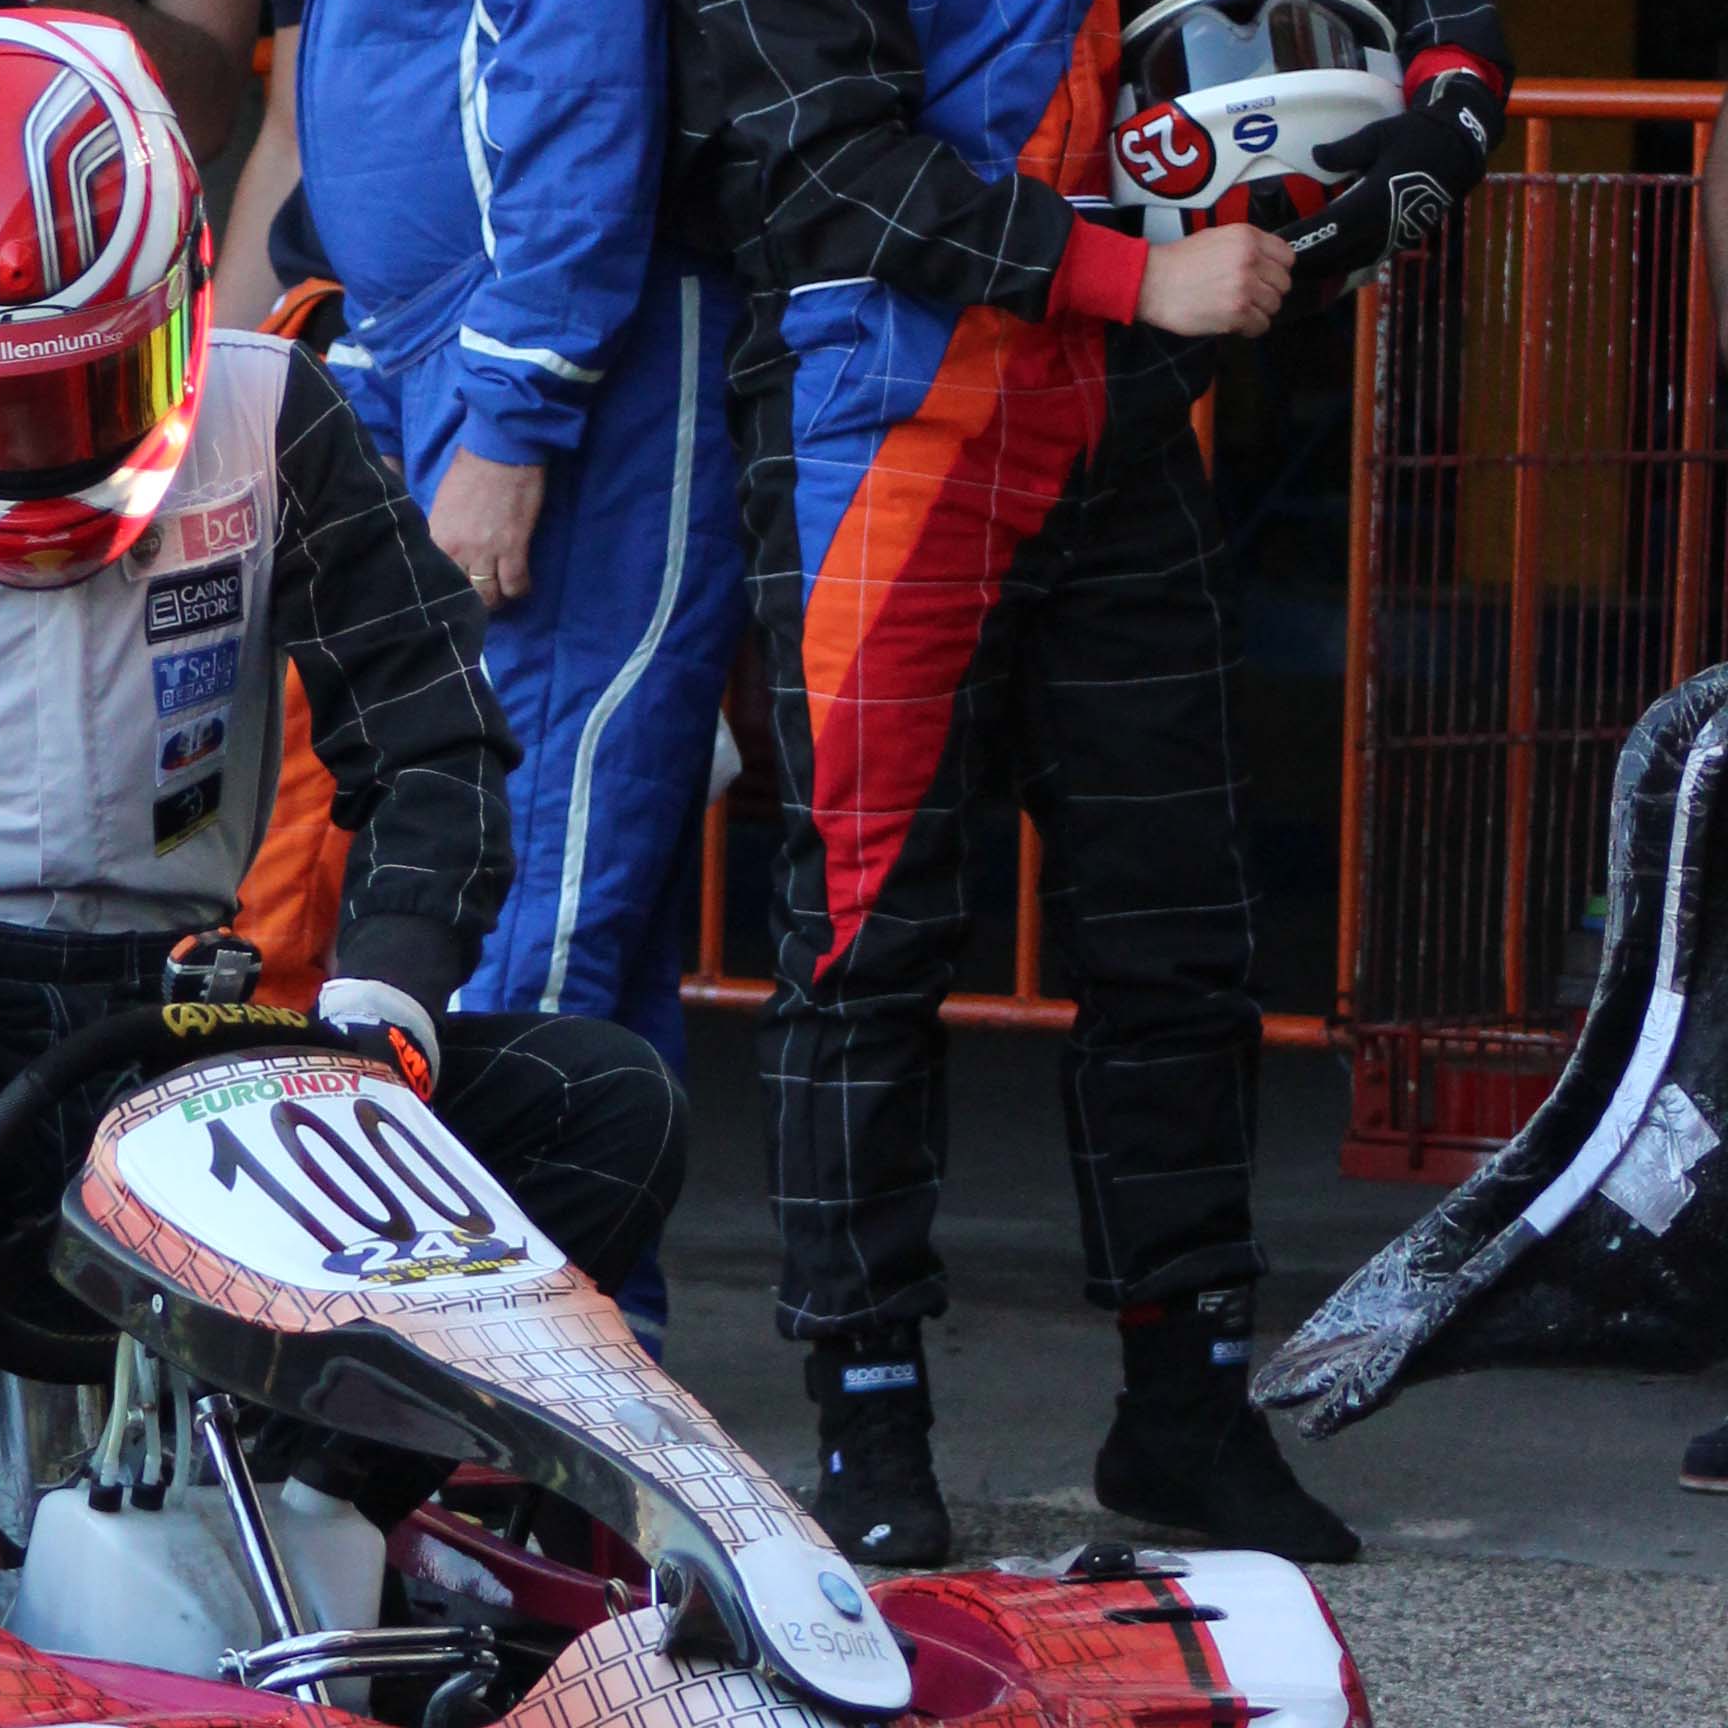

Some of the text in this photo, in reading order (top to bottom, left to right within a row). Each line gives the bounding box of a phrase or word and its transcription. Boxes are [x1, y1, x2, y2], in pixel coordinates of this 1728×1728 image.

[1121, 114, 1199, 183] 25
[203, 504, 255, 550] bcp
[180, 1073, 362, 1123] EUROINDY
[206, 1098, 496, 1253] 100
[343, 1230, 470, 1272] 24
[810, 1622, 889, 1662] Spirit
